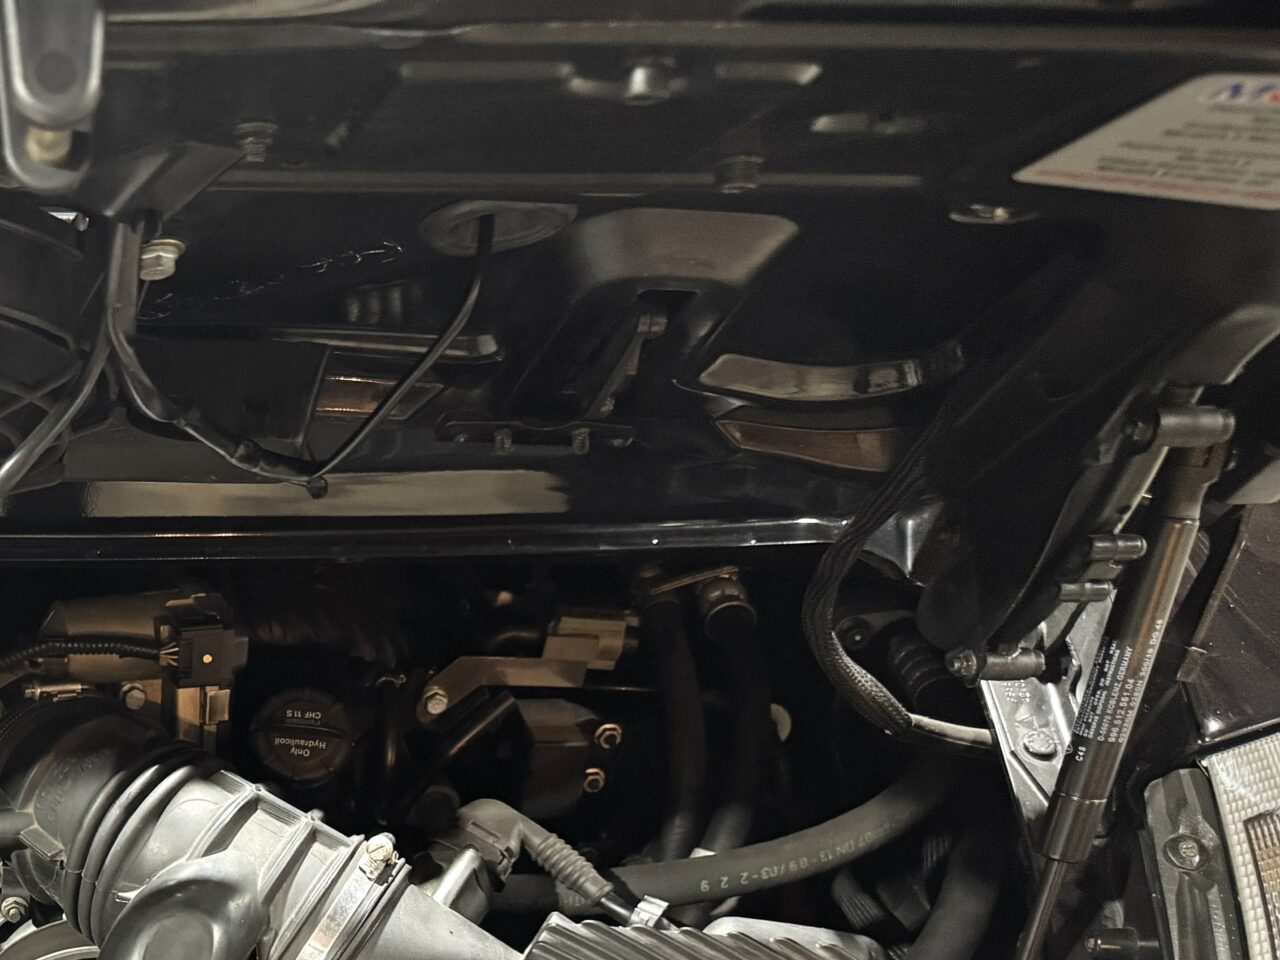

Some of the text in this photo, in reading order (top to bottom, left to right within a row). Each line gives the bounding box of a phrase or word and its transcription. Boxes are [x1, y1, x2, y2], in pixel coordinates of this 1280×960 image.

[1115, 645, 1133, 681] GERMANY
[293, 710, 302, 718] 11
[304, 710, 322, 719] CHF
[274, 737, 326, 749] Hydraulicoil
[289, 747, 310, 757] Only
